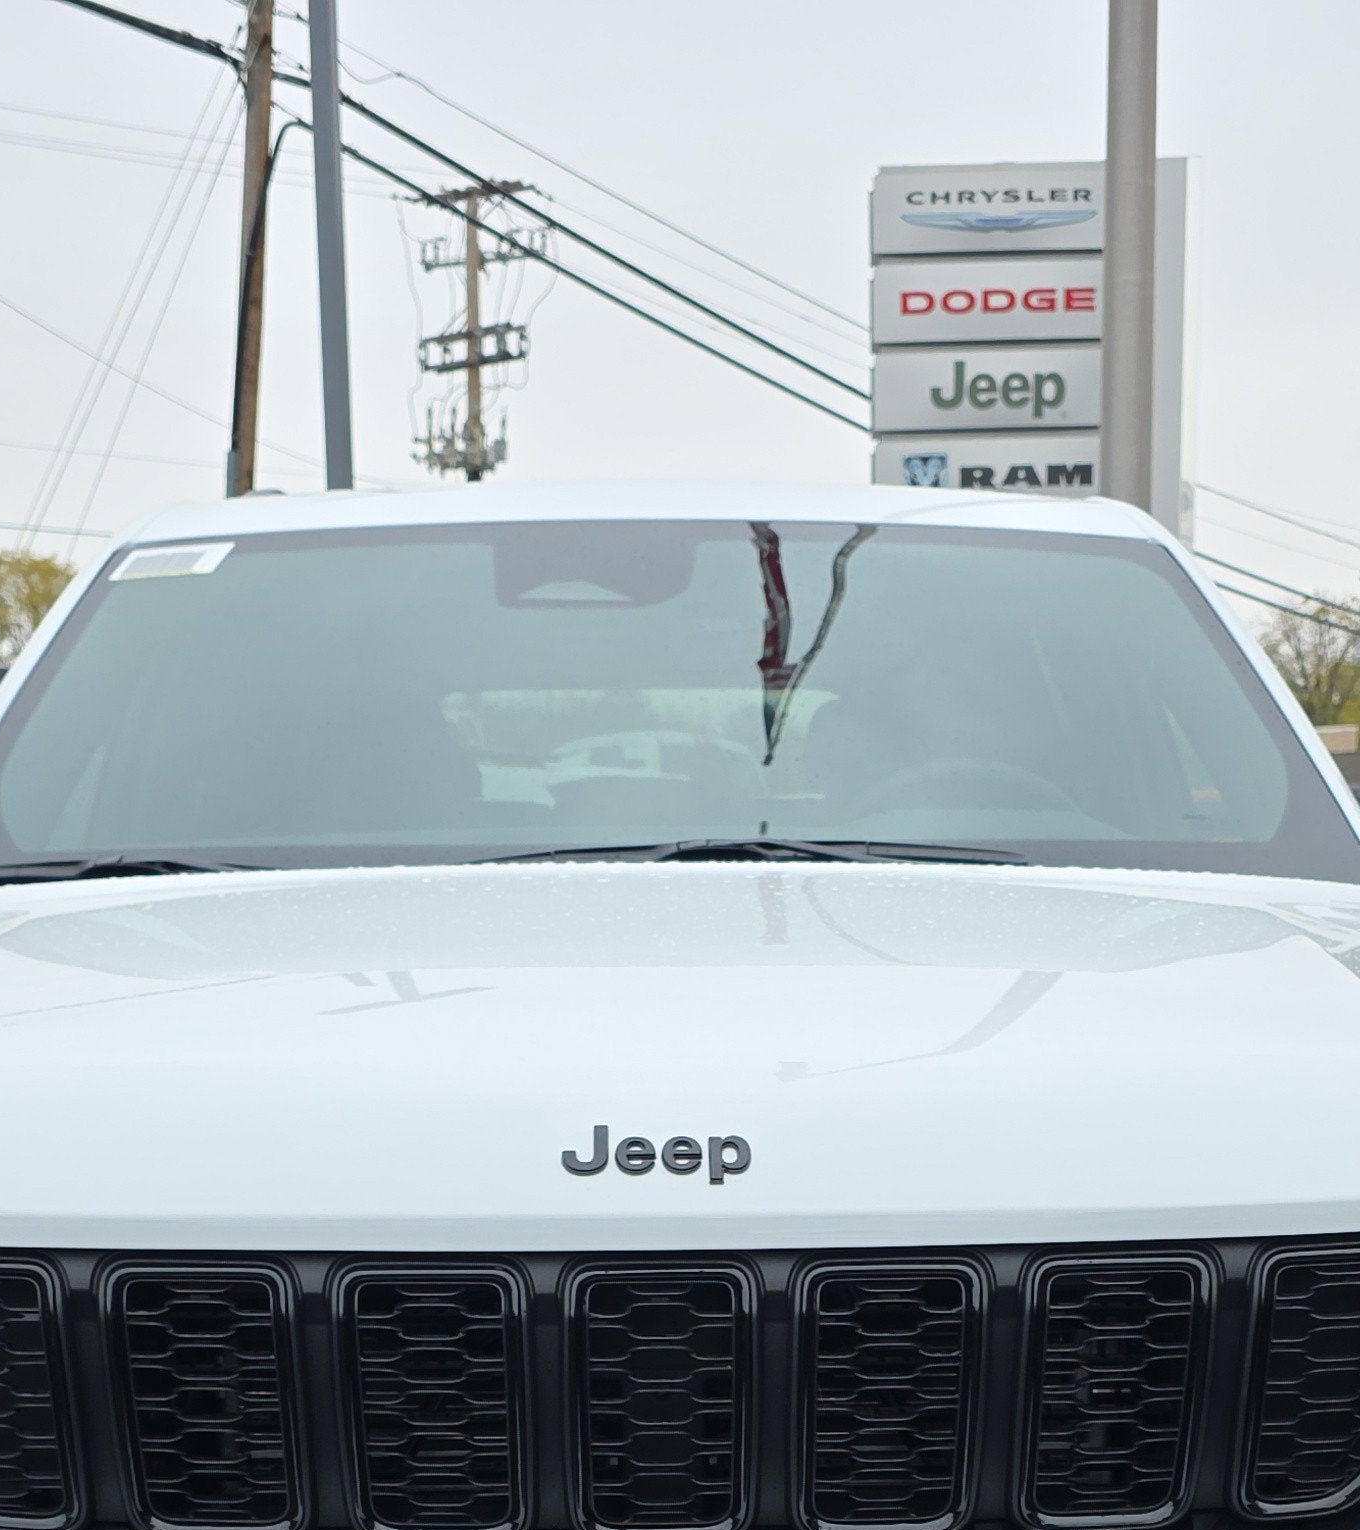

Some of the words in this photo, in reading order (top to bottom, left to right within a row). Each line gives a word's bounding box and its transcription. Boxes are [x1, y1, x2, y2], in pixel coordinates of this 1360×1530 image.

[905, 188, 1093, 205] CHRYSLER
[899, 287, 1097, 317] DODGE
[930, 360, 1065, 418] Jeep
[958, 463, 1094, 489] RAM
[561, 1124, 752, 1185] Jeep
